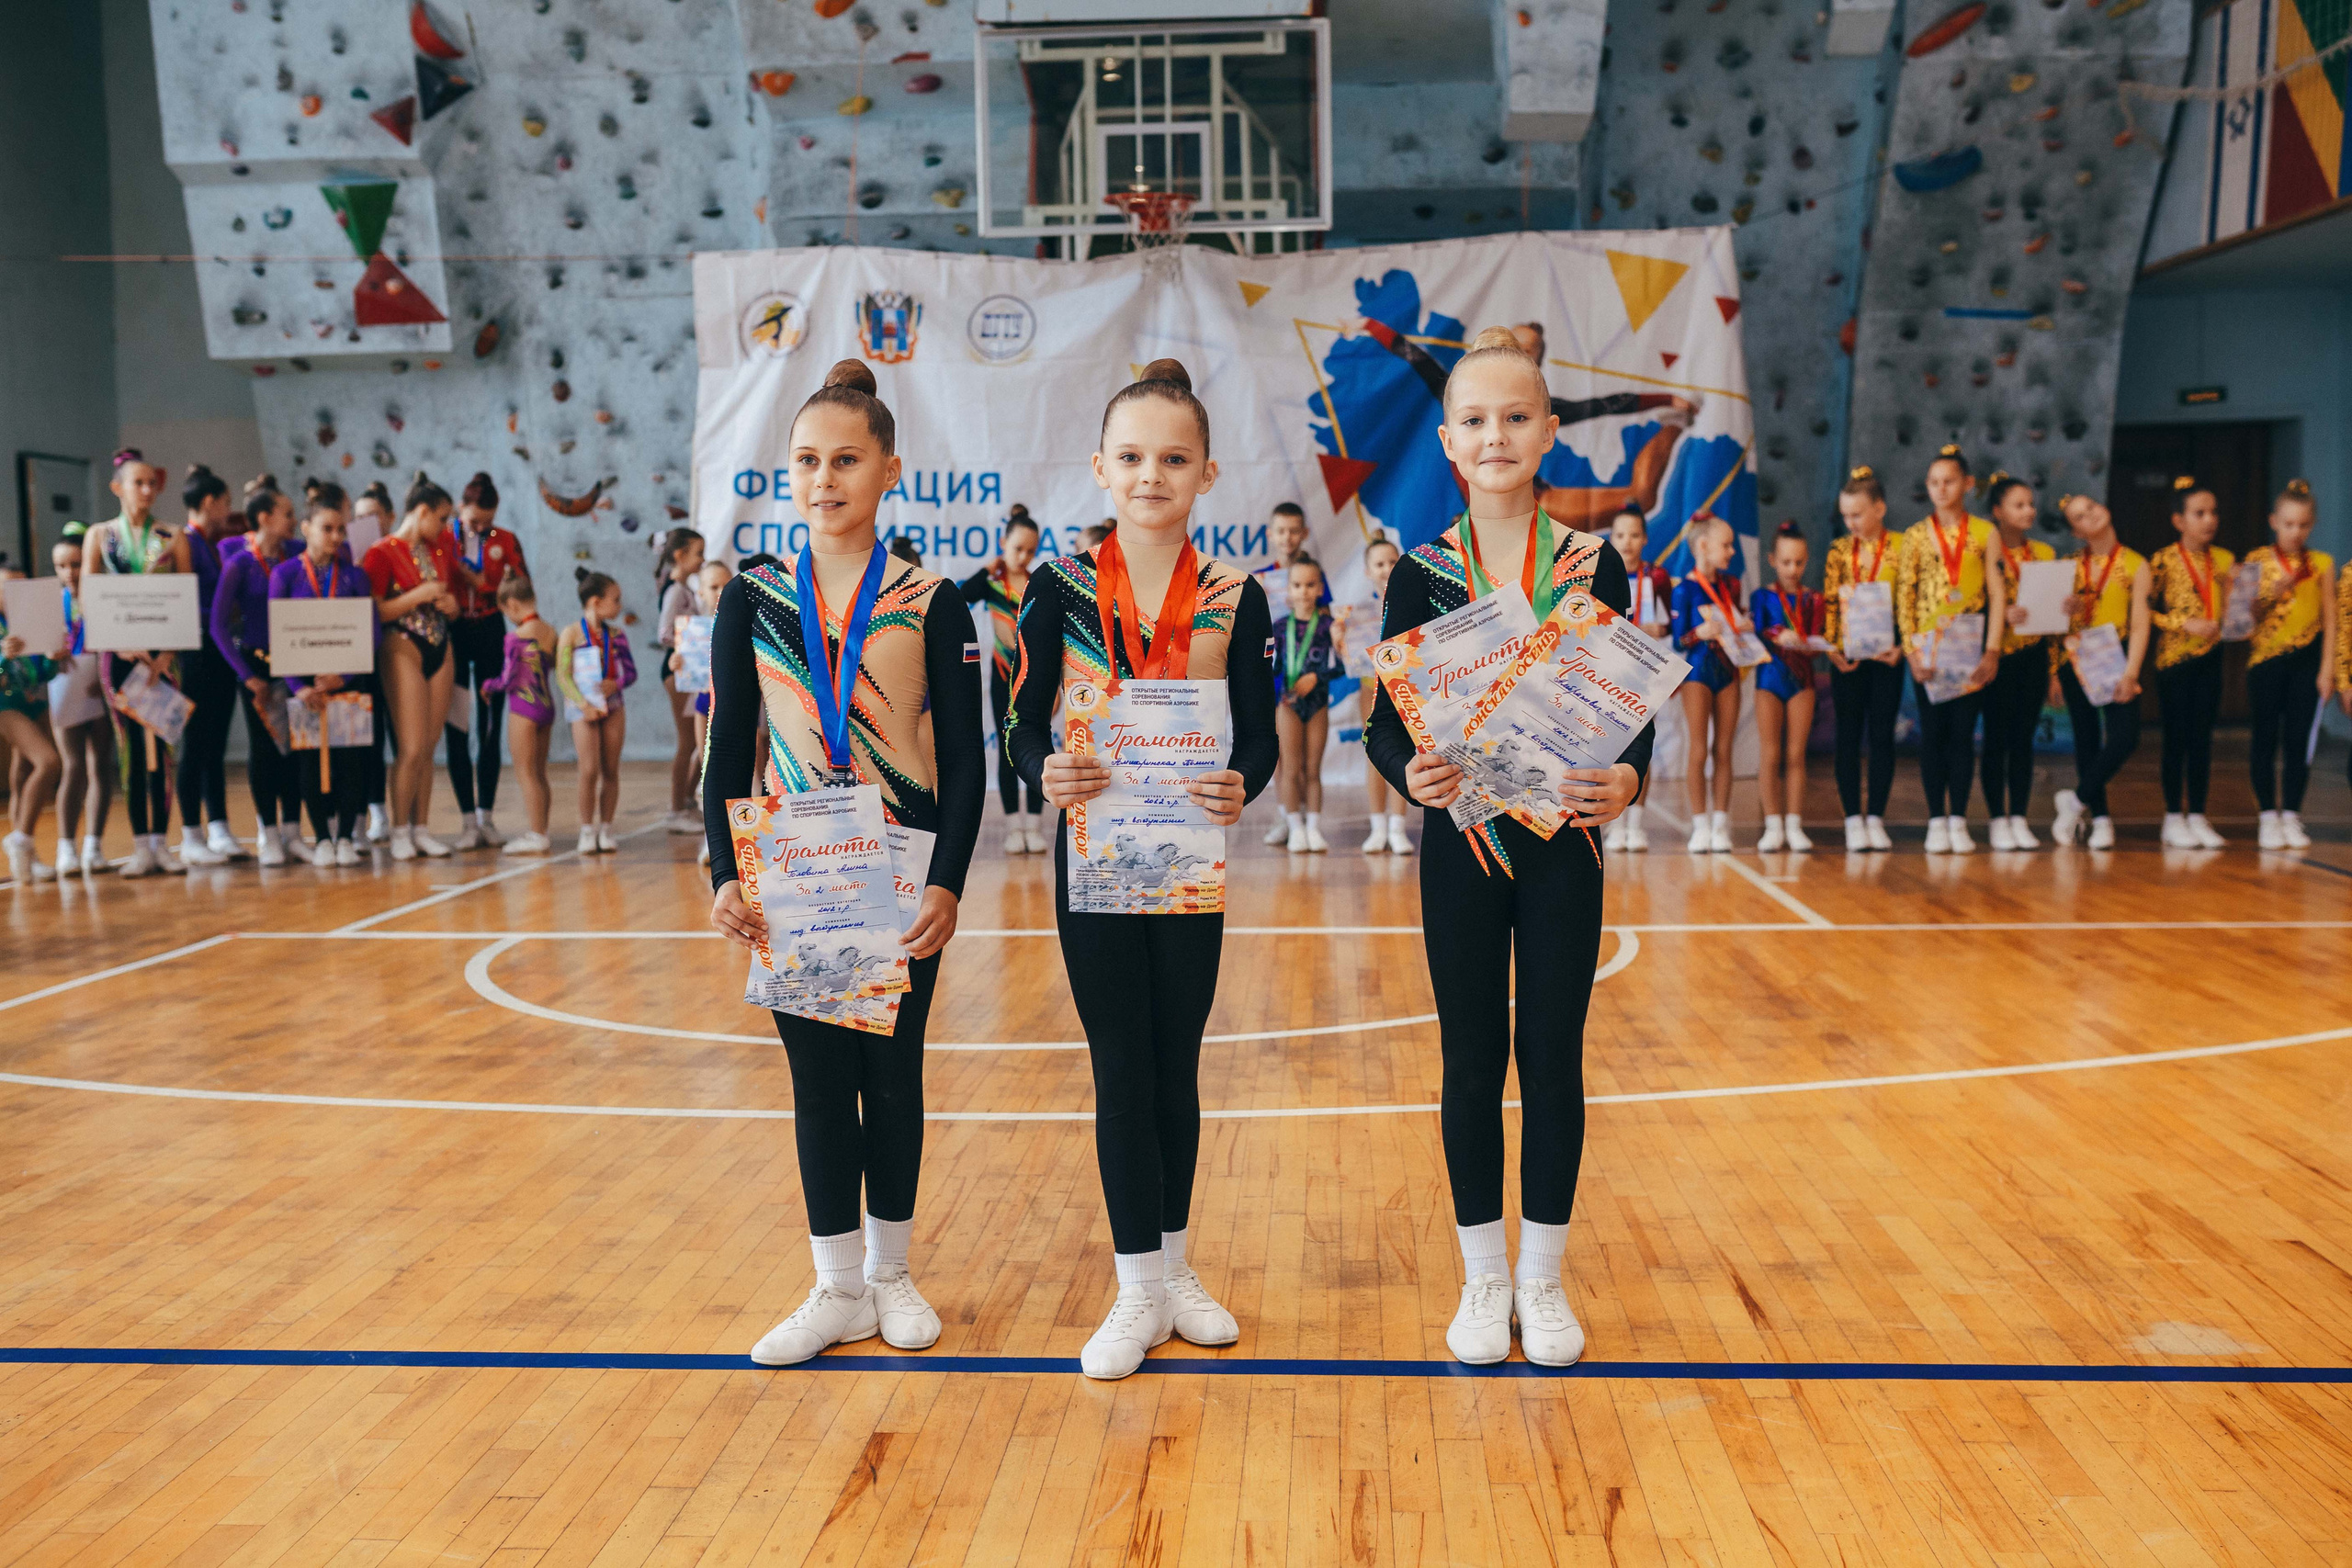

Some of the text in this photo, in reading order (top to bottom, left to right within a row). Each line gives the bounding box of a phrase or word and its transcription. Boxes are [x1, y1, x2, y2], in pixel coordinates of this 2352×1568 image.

[733, 469, 1001, 508] ФЕАЦИЯ
[733, 518, 1268, 558] СПОИВНО АЭИКИ
[1433, 600, 1498, 634] ОТКРЫТЫЕ РЕГИОНАЛЬНЫЕ
[1435, 618, 1474, 639] СОРЕВНОВАНИЯ
[1446, 622, 1478, 641] СПОРТИВНОЙ
[1478, 610, 1503, 626] АЭРОБИКЕ
[1613, 632, 1645, 655] СОРЕВНОВАНИЯ
[1615, 640, 1642, 662] СПОРТИВНОЙ
[1640, 659, 1661, 675] АЭРОБИКЕ
[1617, 626, 1669, 665] ОТКРЫТЫЕ РЕГИОНАЛЬНЫЕ
[1464, 676, 1517, 741] ДОНСКАЯ
[1516, 632, 1555, 677] ОСЕНЬ
[1560, 646, 1648, 716] Грамота
[1396, 685, 1426, 730] ОСЕНЬ
[1547, 693, 1563, 709] За
[1574, 716, 1607, 738] место
[1609, 699, 1643, 723] НАГРАЖДАЕТСЯ
[1074, 728, 1086, 756] ЕНЬ
[1104, 722, 1219, 760] Грамота
[1122, 771, 1139, 784] За
[790, 795, 855, 807] ОТКРЫТЫЕ РЕГИОНАЛЬНЫЕ
[791, 805, 829, 813] СОРЕВНОВАНИЯ
[800, 810, 831, 818] СПОРТИВНОЙ
[1073, 801, 1089, 859] ДОНСК
[773, 835, 882, 874] Грамота
[840, 851, 884, 860] НАГРАЖДАЕТСЯ
[888, 843, 908, 853] РОБИКЕ
[742, 845, 760, 896] ОСЕНЬ
[796, 883, 811, 897] За
[829, 880, 867, 893] место
[752, 900, 775, 971] ДОНЯ
